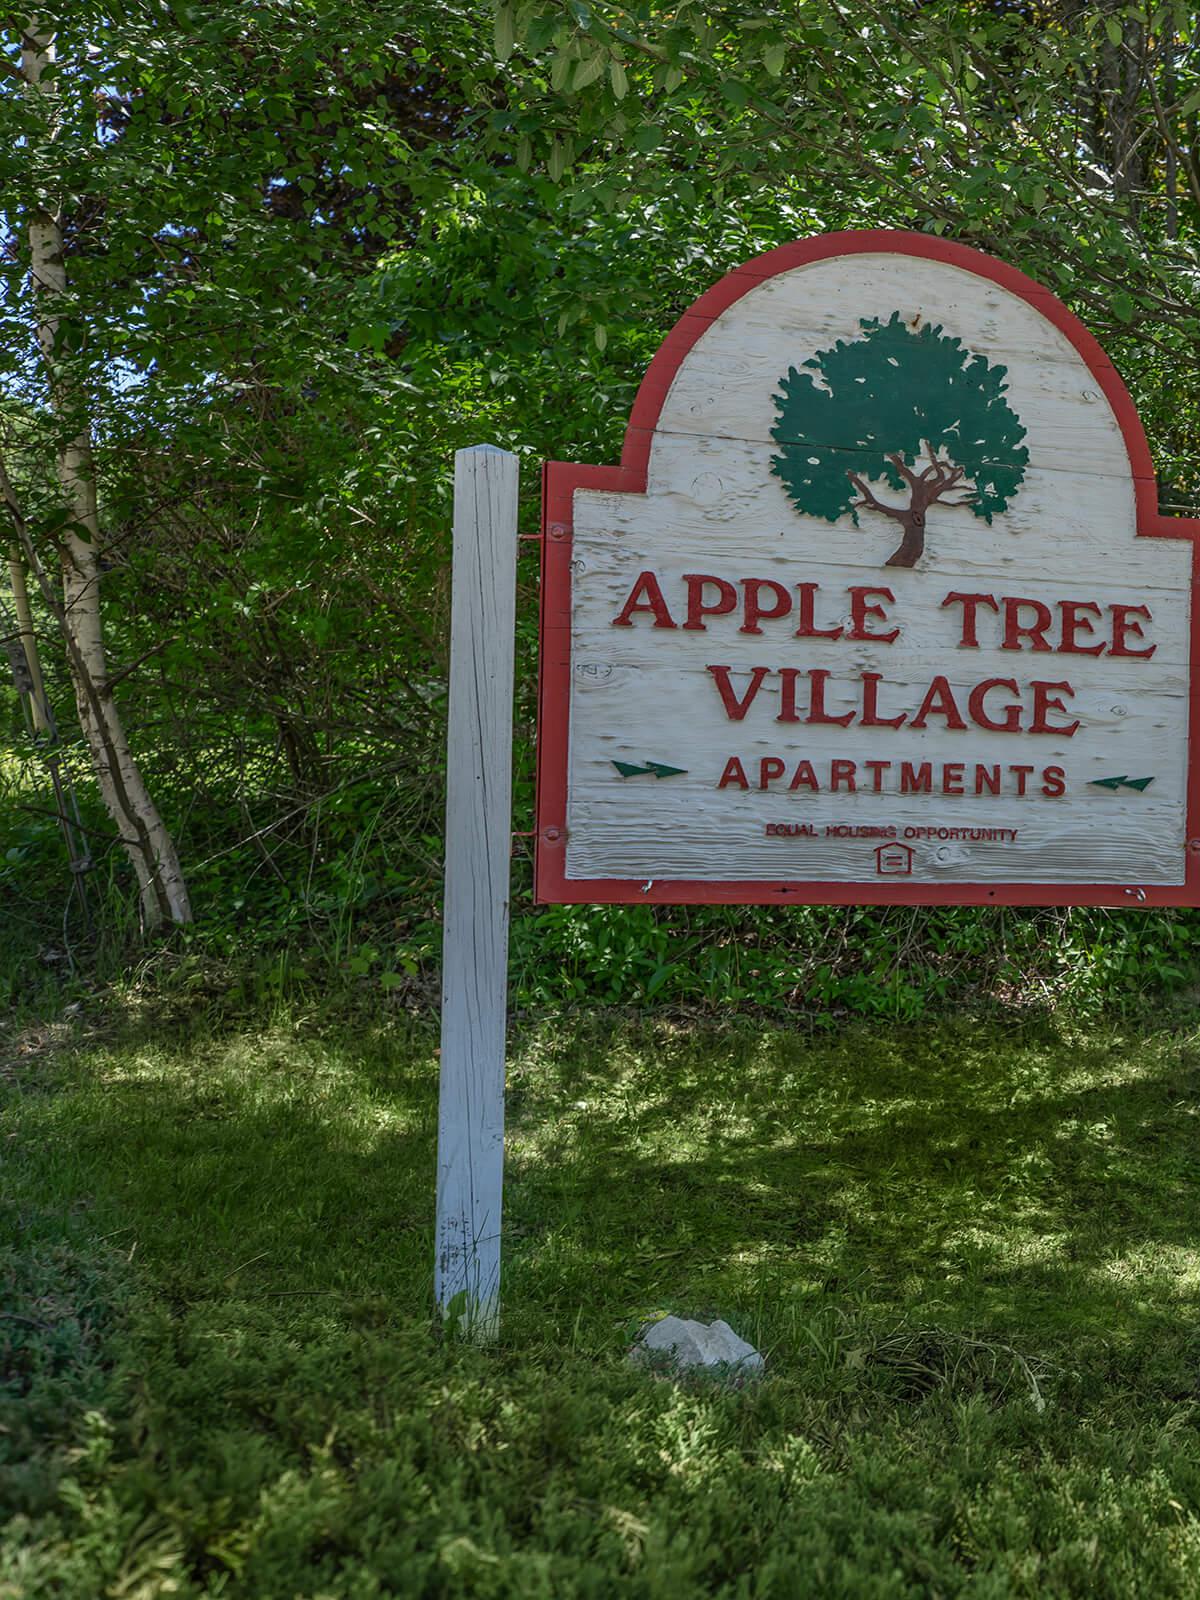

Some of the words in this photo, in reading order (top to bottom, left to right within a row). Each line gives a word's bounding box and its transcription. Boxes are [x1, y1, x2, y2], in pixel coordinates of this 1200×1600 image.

[612, 571, 900, 643] APPLE
[941, 591, 1156, 659] TREE
[707, 666, 1078, 736] VILLAGE
[718, 756, 1066, 797] APARTMENTS
[765, 823, 818, 837] EQUAL
[825, 825, 897, 839] HOUSING
[903, 826, 1018, 842] OPPORTUNITY
